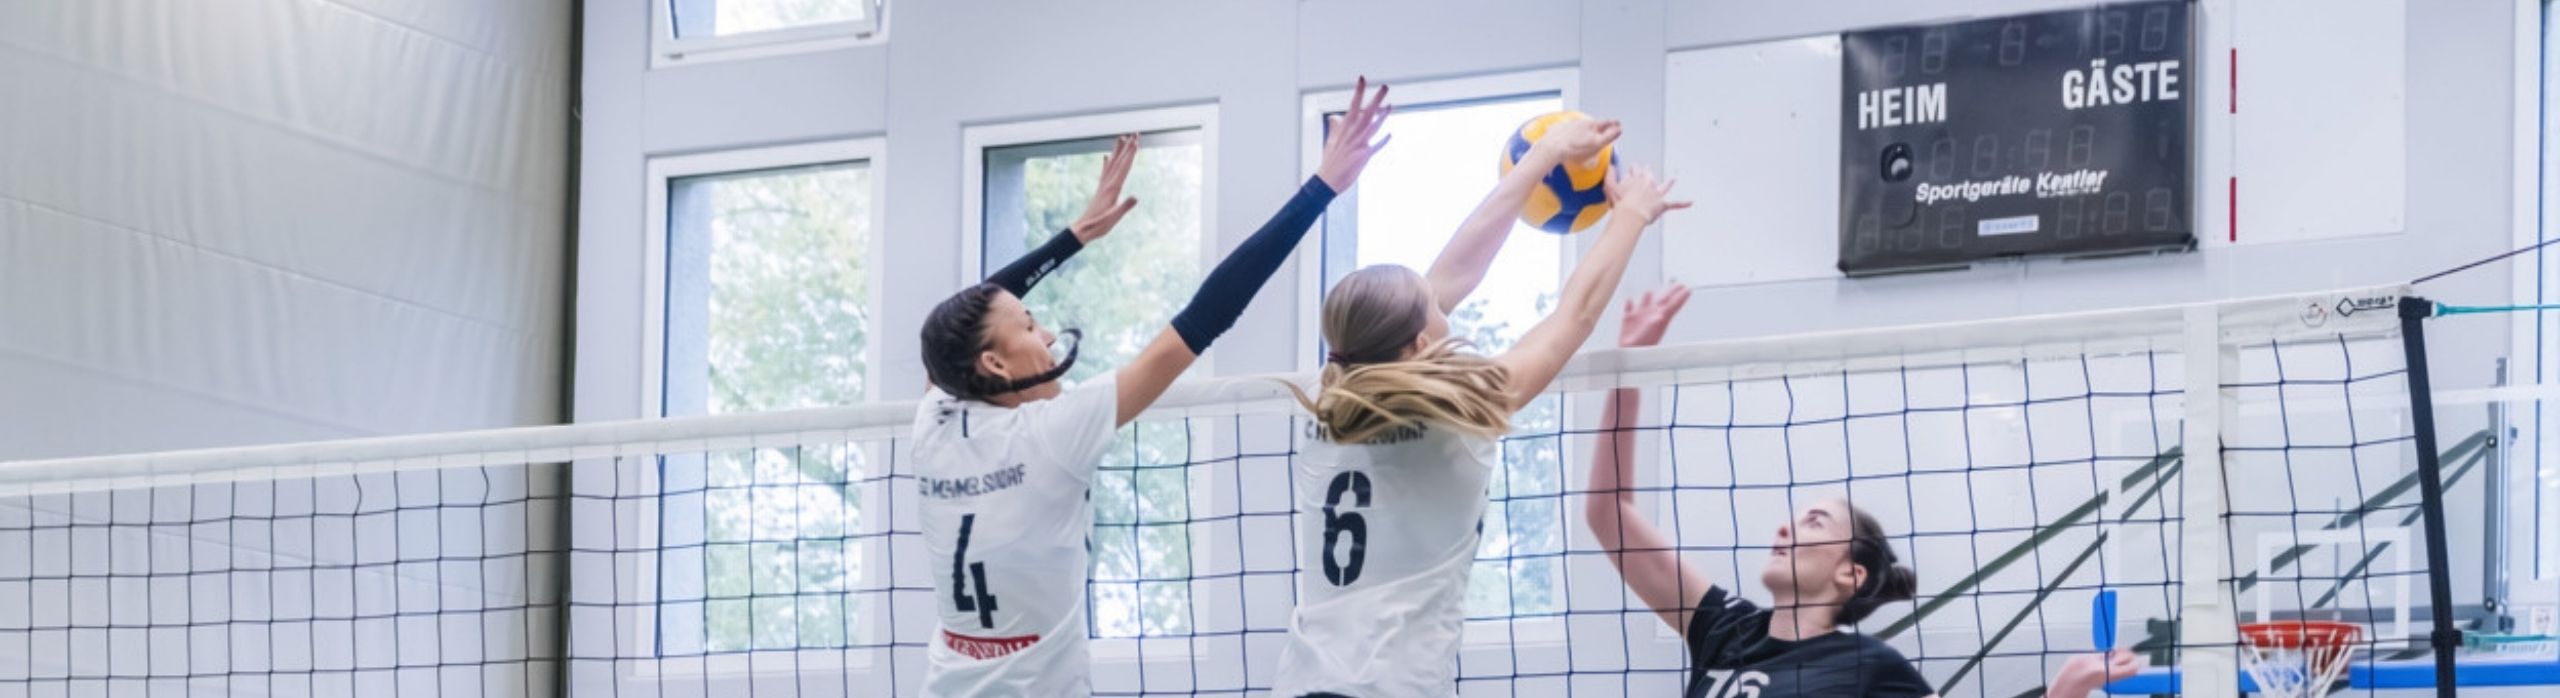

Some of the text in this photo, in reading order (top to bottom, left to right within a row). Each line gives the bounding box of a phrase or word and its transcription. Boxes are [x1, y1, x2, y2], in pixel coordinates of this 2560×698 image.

[1858, 83, 1947, 130] HEIM
[2063, 58, 2181, 110] GÄSTE
[1915, 175, 2031, 205] Sportgeräte
[1322, 470, 1372, 587] 6
[952, 513, 998, 629] 4
[1704, 669, 1771, 698] 16
